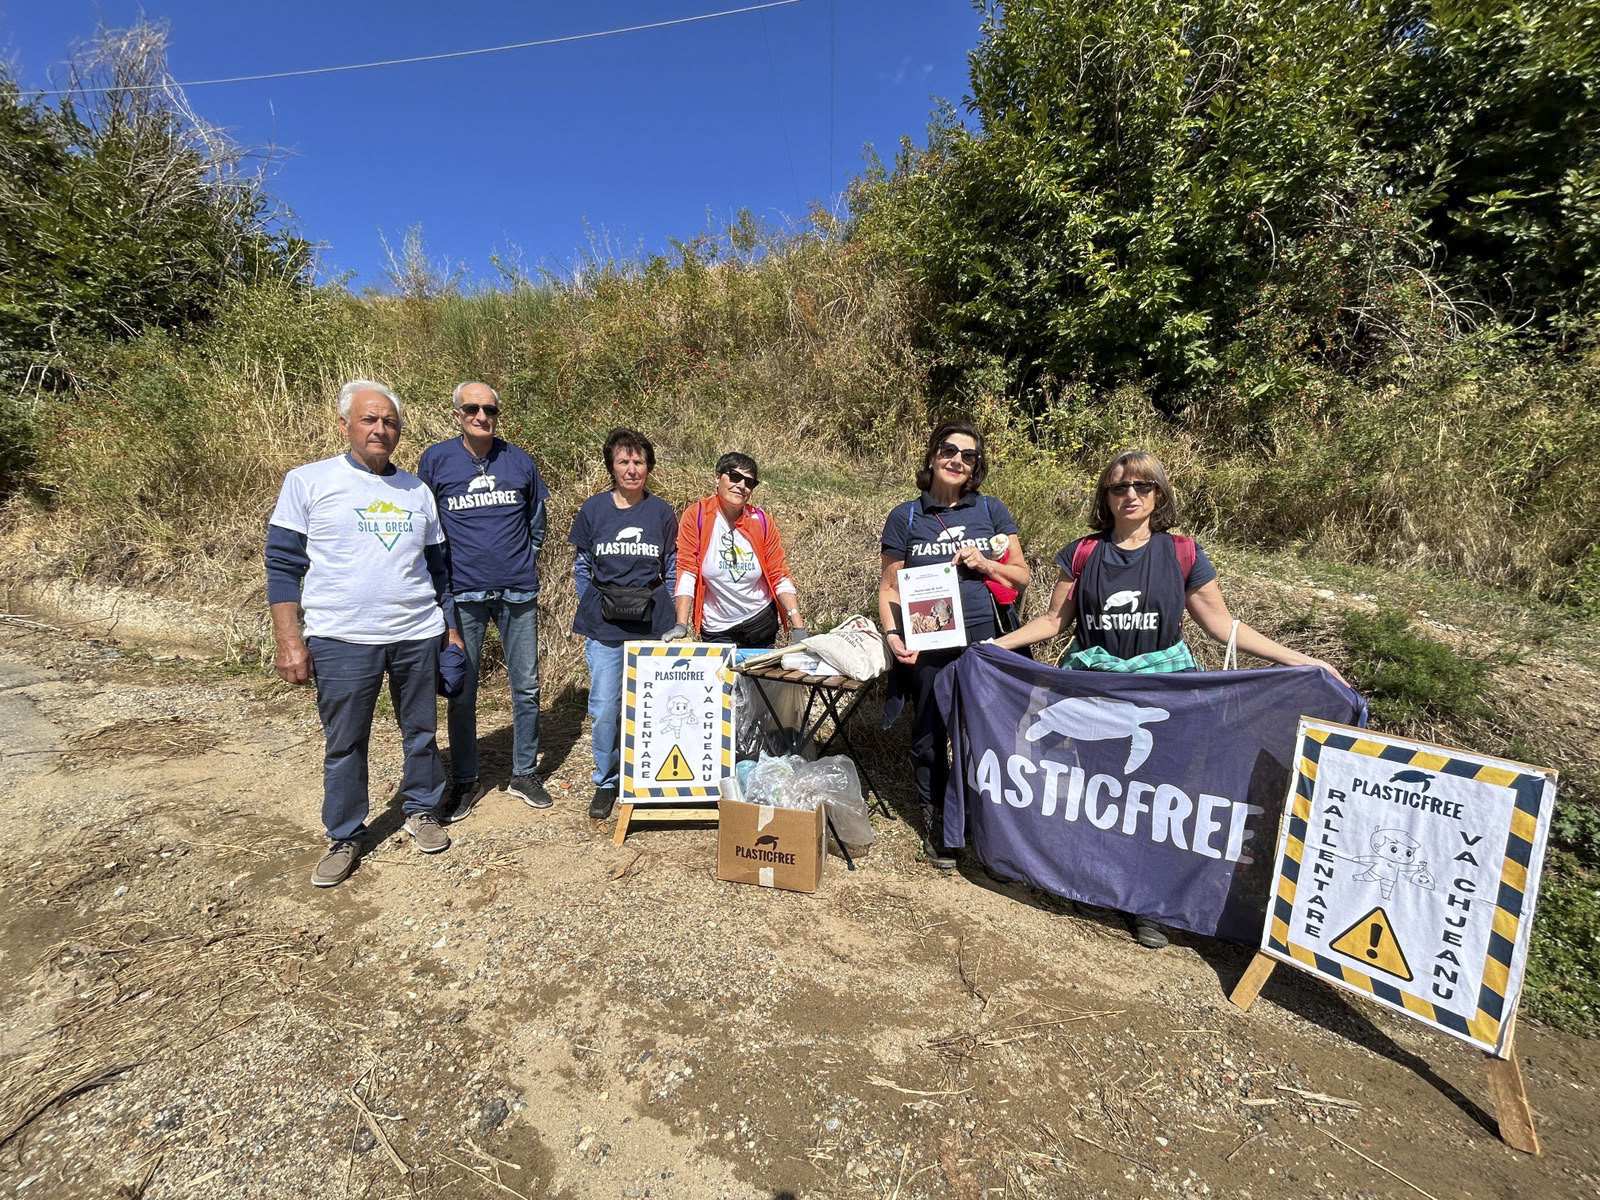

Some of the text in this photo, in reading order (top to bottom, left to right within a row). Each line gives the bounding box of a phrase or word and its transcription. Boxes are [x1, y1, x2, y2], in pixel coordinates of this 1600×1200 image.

[447, 490, 517, 511] PLASTICFREE
[358, 521, 414, 533] SILA GRECA
[595, 541, 660, 558] PLASTICFREE
[655, 671, 705, 681] PLASTICFREE
[641, 681, 653, 779] RALLENTARE
[702, 686, 714, 782] VA CHJEANU
[1351, 777, 1465, 820] PLASTICFREE
[735, 845, 796, 865] PLASTICFREE
[1304, 788, 1347, 939] RALLENTARE
[1431, 830, 1483, 1000] VA CHJEANU
